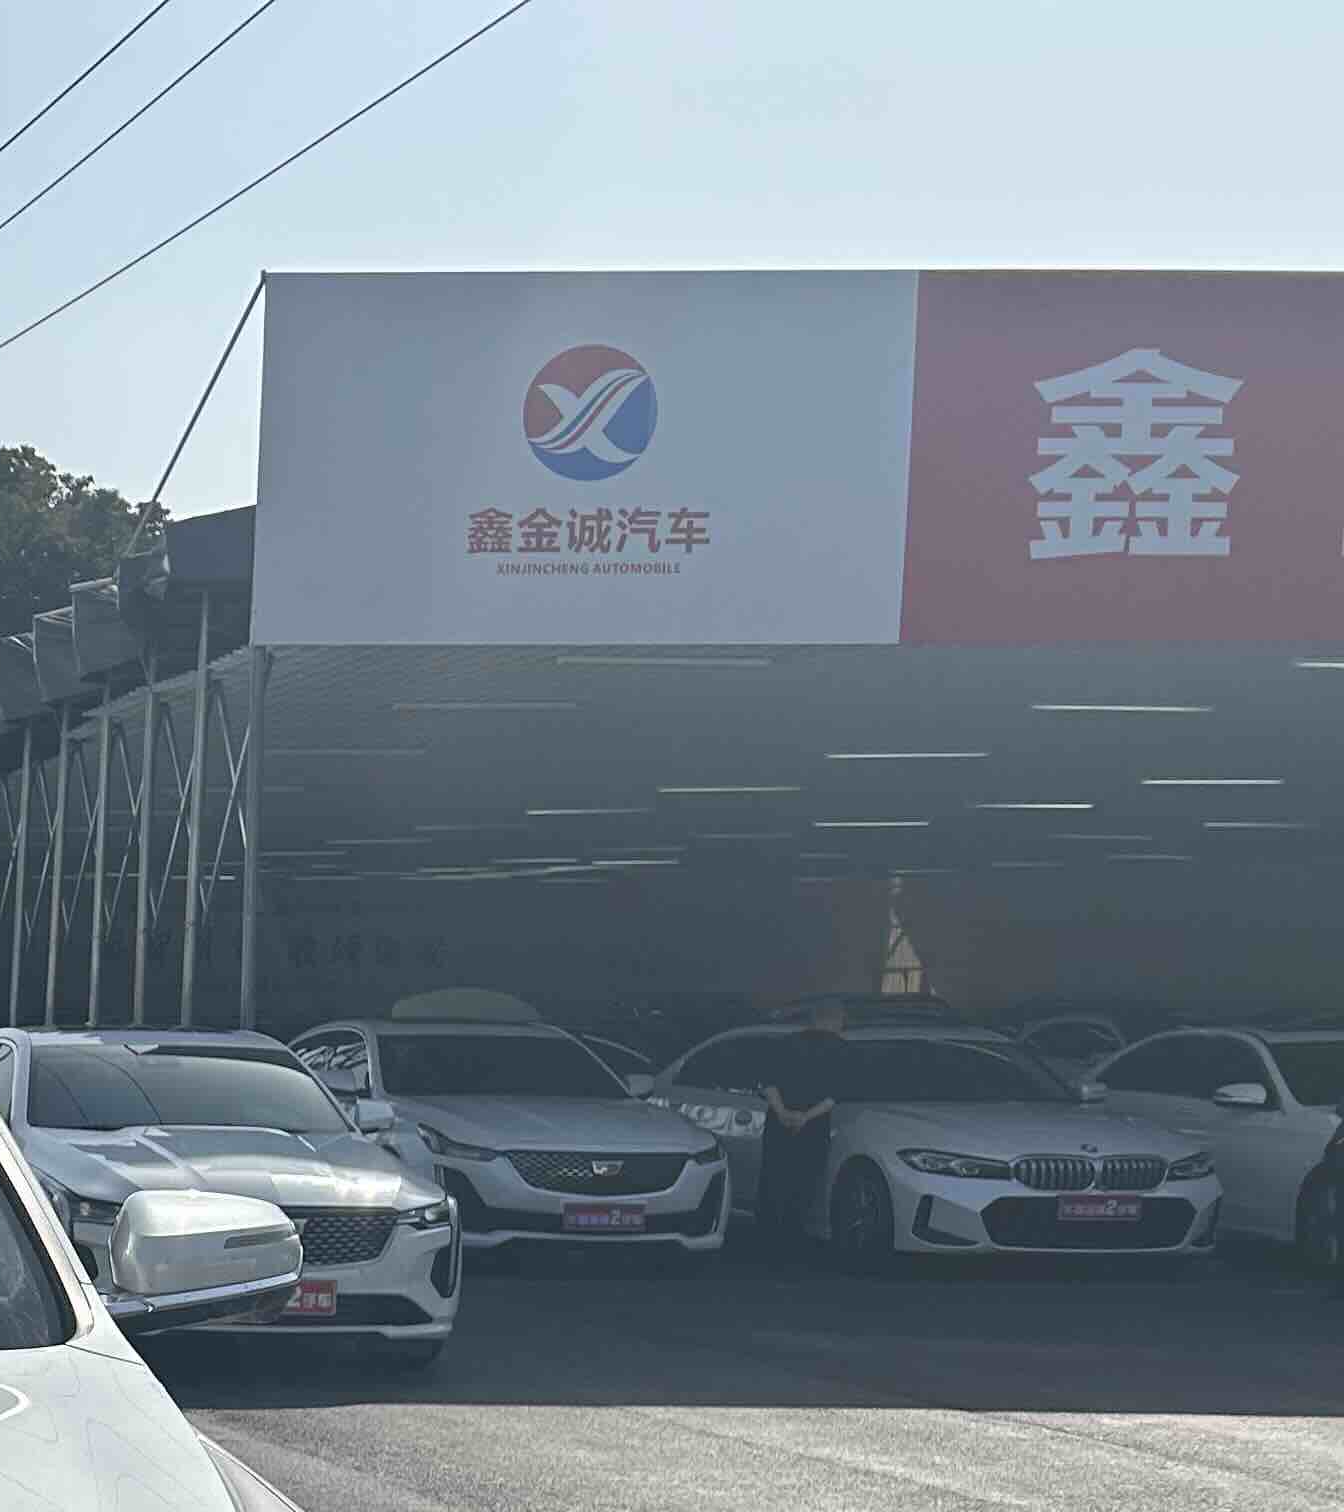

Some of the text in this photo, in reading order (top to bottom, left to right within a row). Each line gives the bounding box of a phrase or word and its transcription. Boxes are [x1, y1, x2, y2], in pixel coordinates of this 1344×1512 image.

[1028, 348, 1245, 560] 鑫
[466, 506, 711, 554] 鑫金诚汽车
[496, 560, 682, 576] XINJINCHENG AUTOMOBILE
